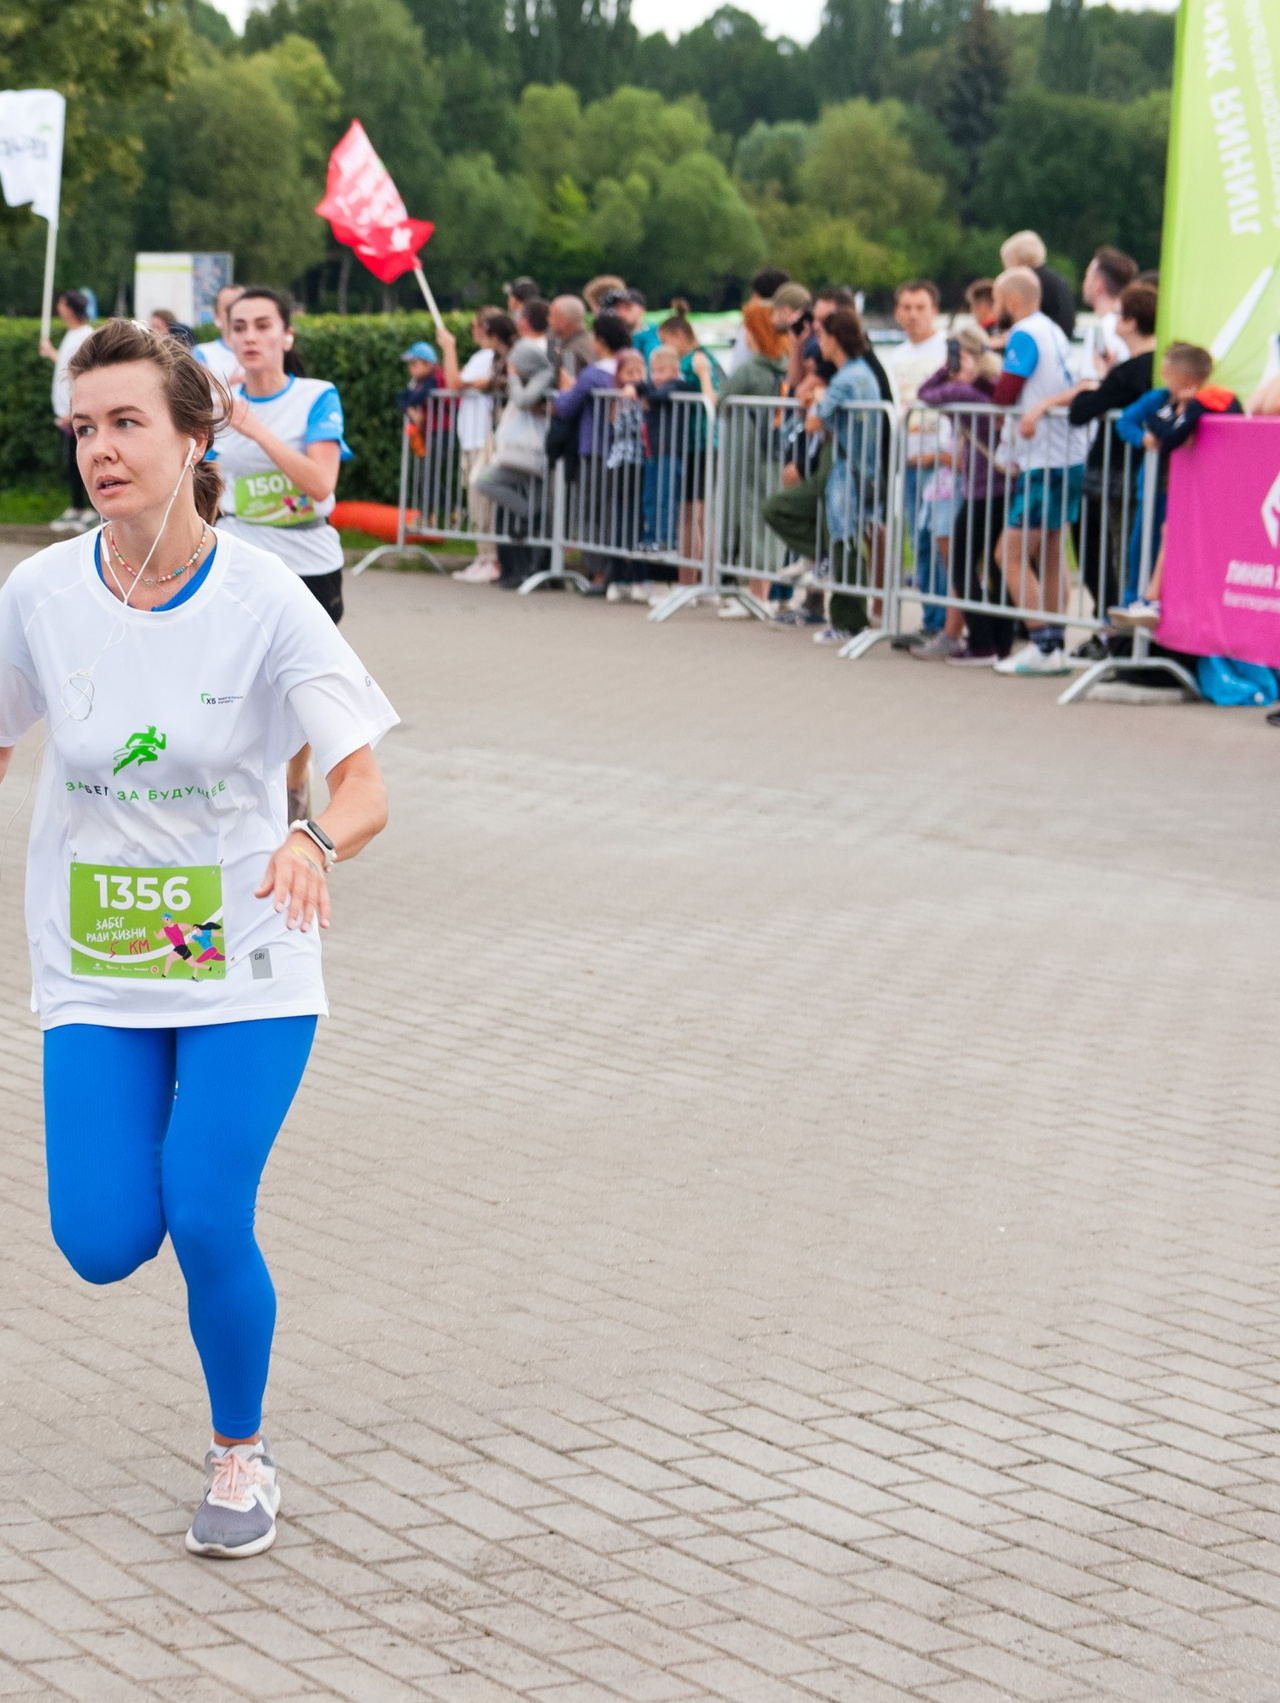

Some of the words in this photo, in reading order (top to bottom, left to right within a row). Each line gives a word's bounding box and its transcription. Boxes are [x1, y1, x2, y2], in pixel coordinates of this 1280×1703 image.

[117, 790, 140, 801] ЗА
[148, 780, 227, 801] БУДУЩЕЕ
[94, 873, 192, 911] 1356
[96, 916, 125, 931] ЗАБЕГ
[86, 931, 109, 943] РАДИ
